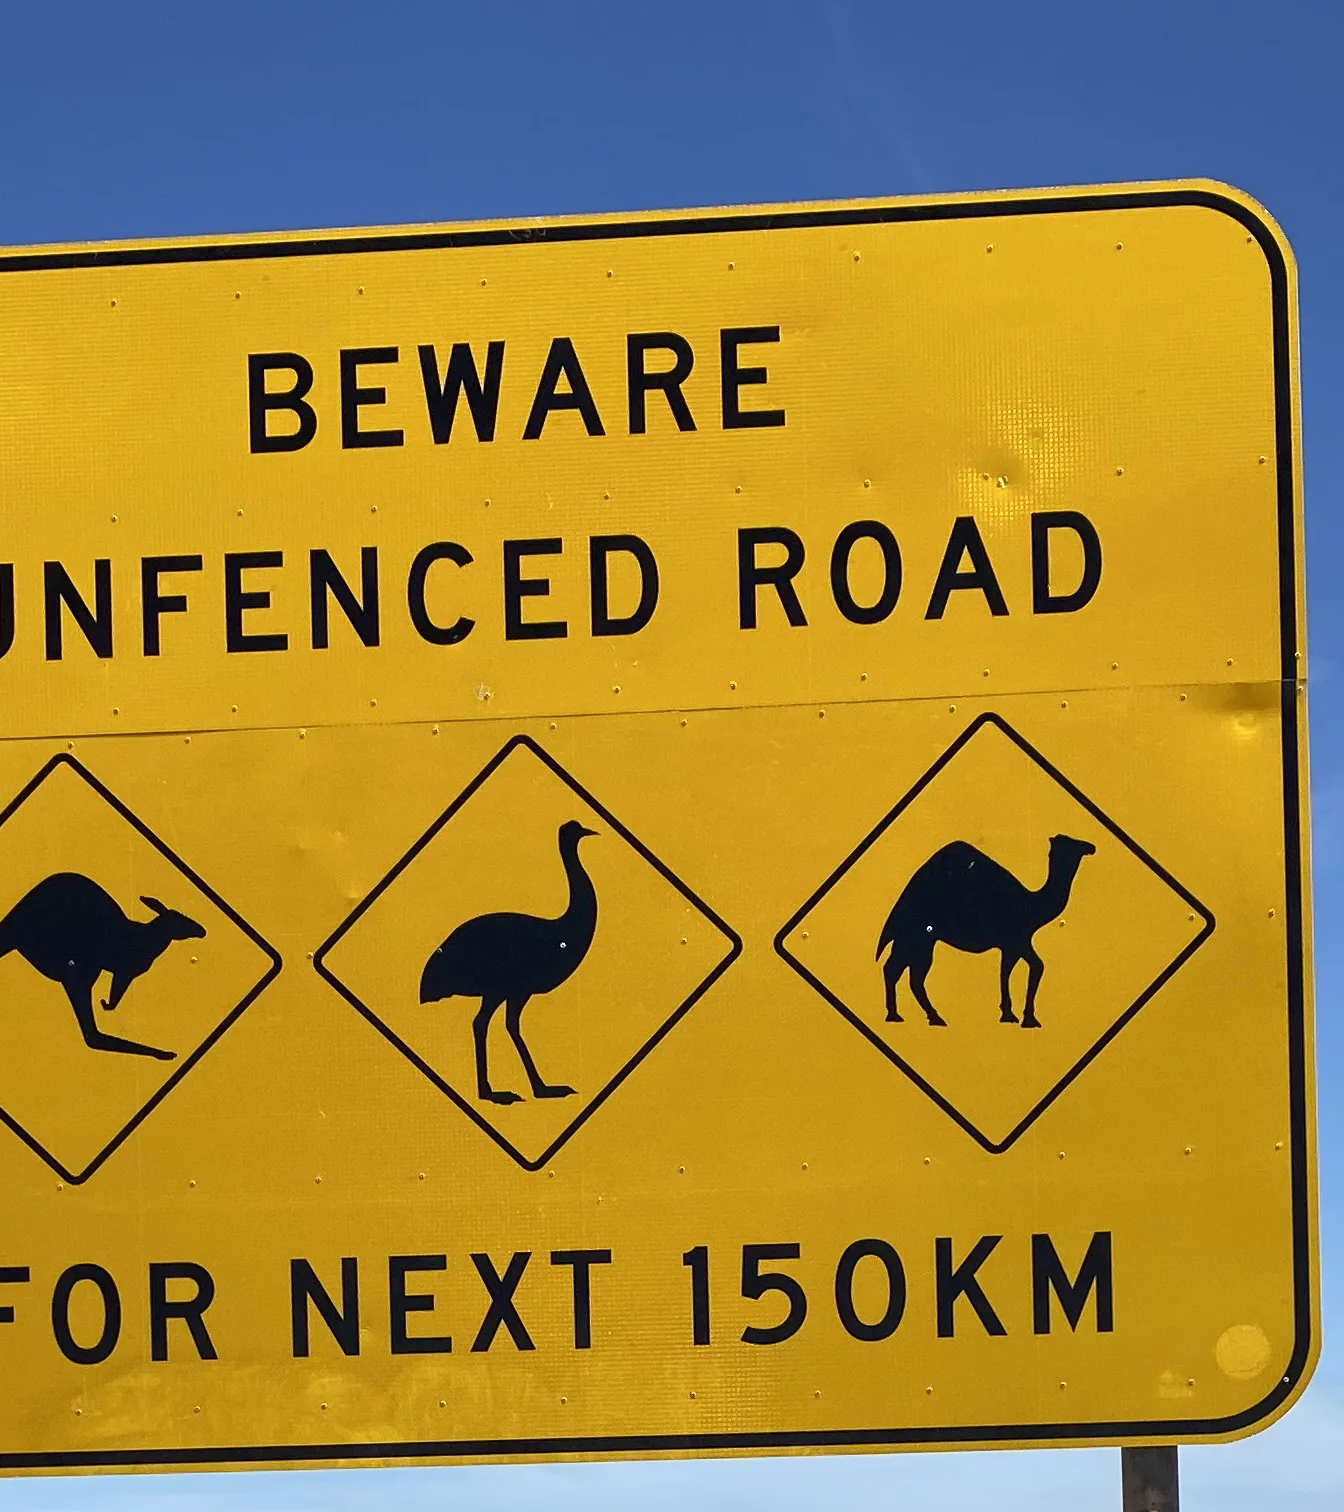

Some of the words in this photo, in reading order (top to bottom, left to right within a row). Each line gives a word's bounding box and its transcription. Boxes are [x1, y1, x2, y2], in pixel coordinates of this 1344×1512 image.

[247, 325, 787, 454] BEWARE
[737, 510, 1103, 630] ROAD
[290, 1249, 613, 1358] NEXT
[682, 1230, 1114, 1347] 150KM
